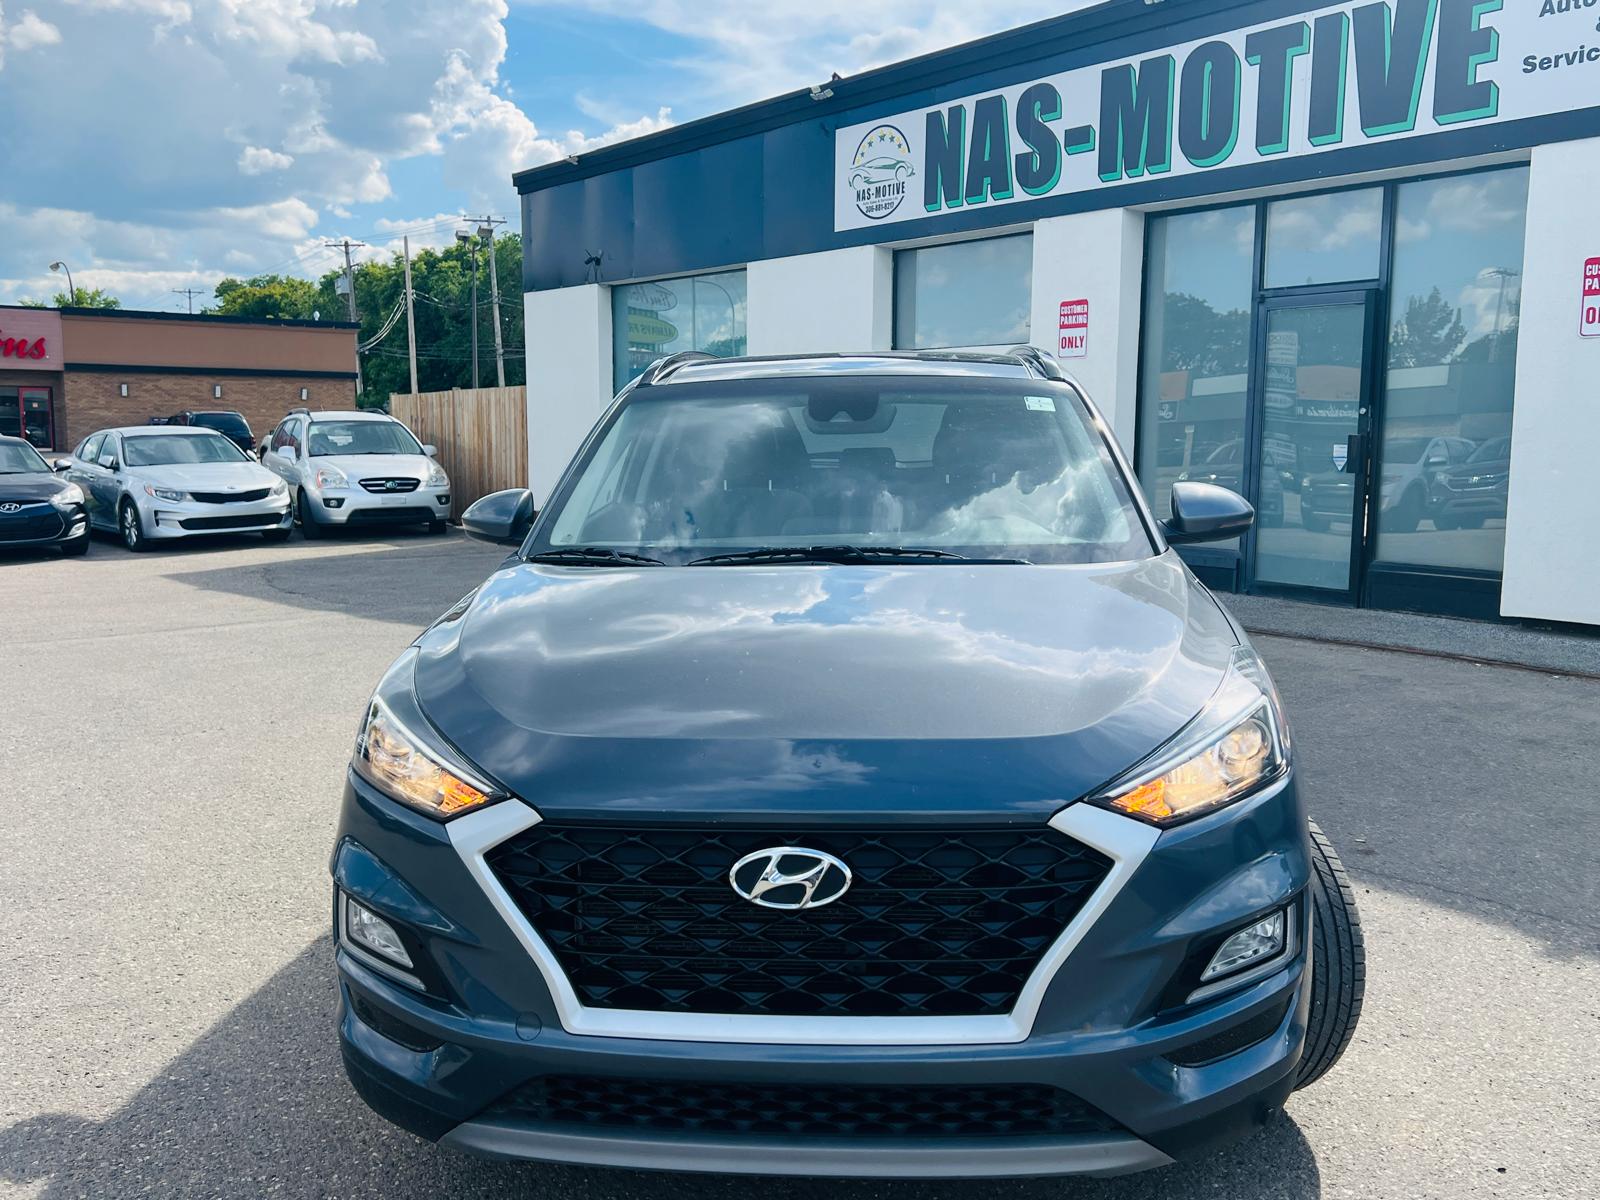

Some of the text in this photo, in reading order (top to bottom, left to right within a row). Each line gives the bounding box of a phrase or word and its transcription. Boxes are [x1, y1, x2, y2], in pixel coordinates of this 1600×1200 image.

[1522, 45, 1600, 74] Servic
[923, 0, 1503, 212] NAS-MOTIVE
[856, 181, 906, 202] NAS-MOTIVE
[1060, 304, 1088, 315] CUSTOMER
[1585, 306, 1600, 325] O
[1060, 314, 1088, 325] PARKING
[1061, 335, 1085, 350] ONLY
